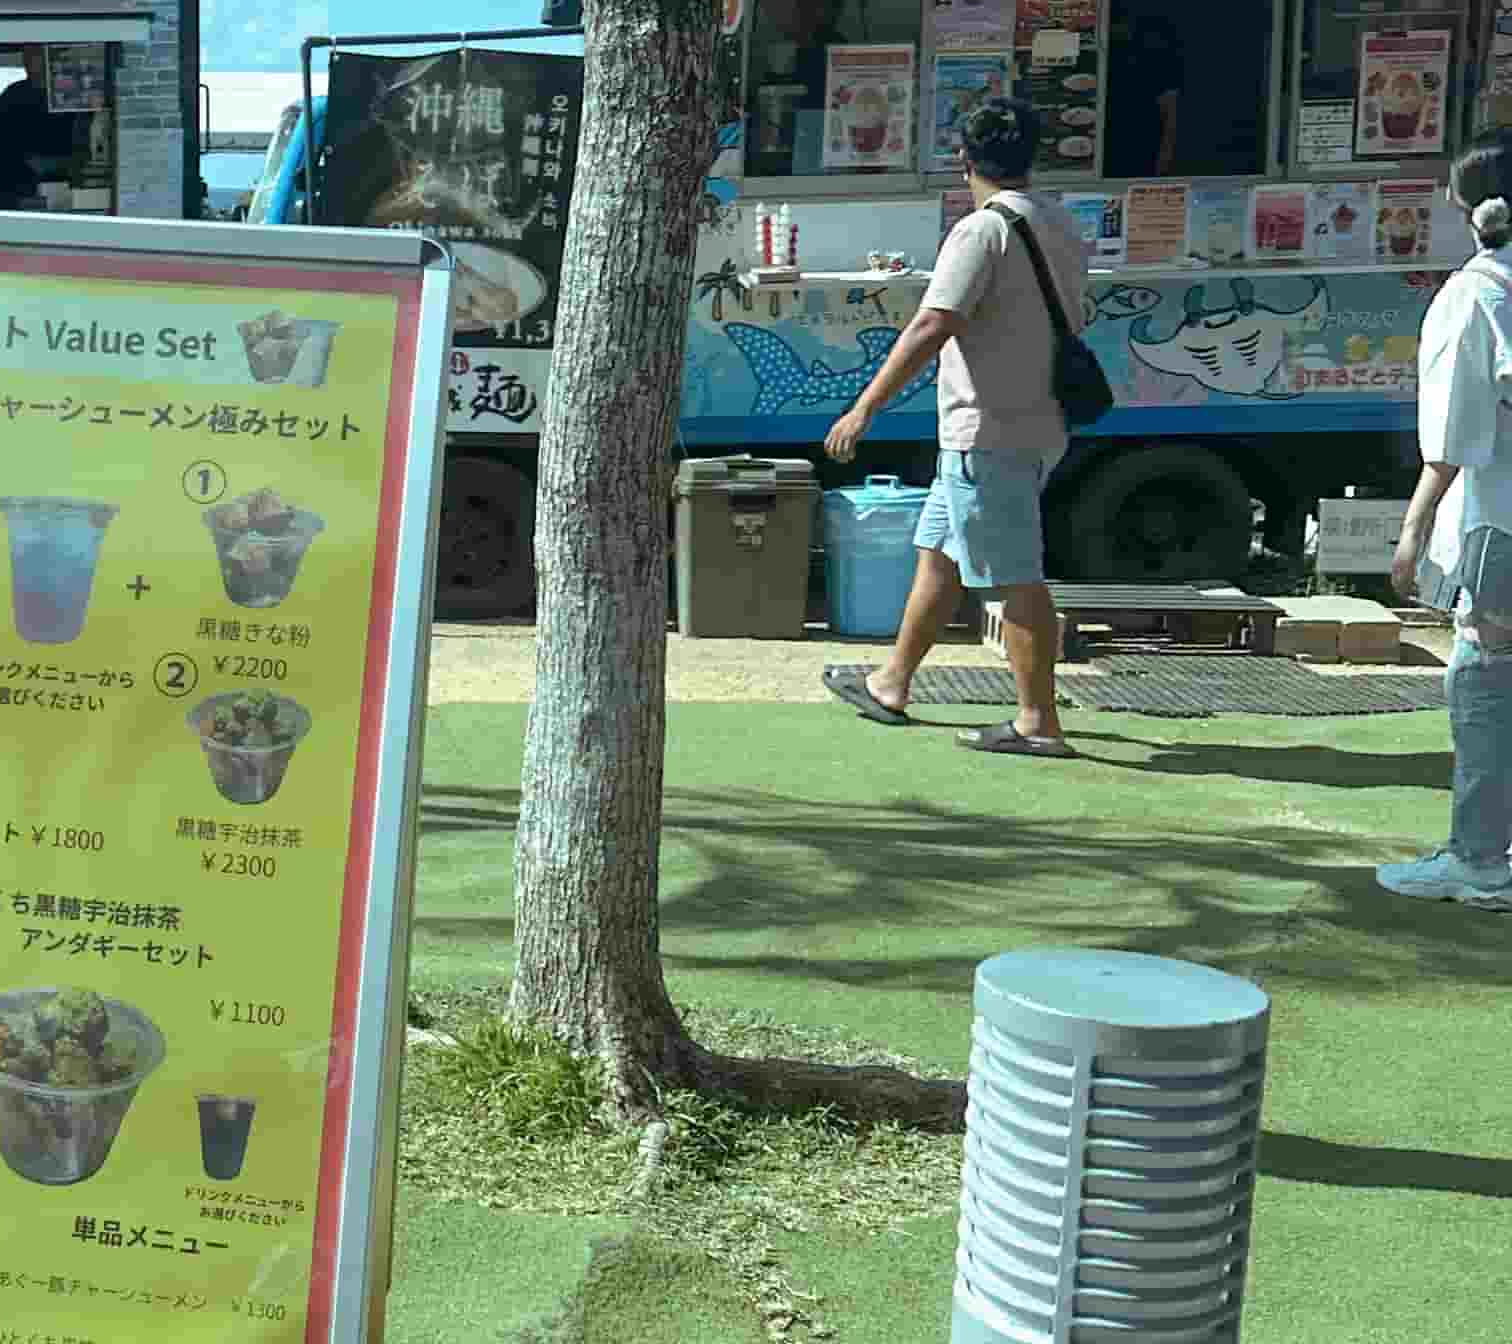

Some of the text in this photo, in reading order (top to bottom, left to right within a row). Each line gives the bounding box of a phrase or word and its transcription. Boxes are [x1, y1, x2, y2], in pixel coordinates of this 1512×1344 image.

[404, 82, 506, 135] 沖縄
[43, 317, 146, 357] Value
[153, 326, 217, 362] Set
[195, 616, 311, 649] 黒糖きな粉
[212, 656, 289, 681] ¥2200
[31, 824, 105, 850] ¥1800
[175, 816, 305, 849] 黒糖宇治抹茶
[200, 854, 277, 878] ¥2300
[20, 927, 215, 969] アンダギーセット
[209, 998, 286, 1027] ¥1100
[71, 1215, 230, 1256] 単品メニュー
[231, 1298, 287, 1321] ¥1300
